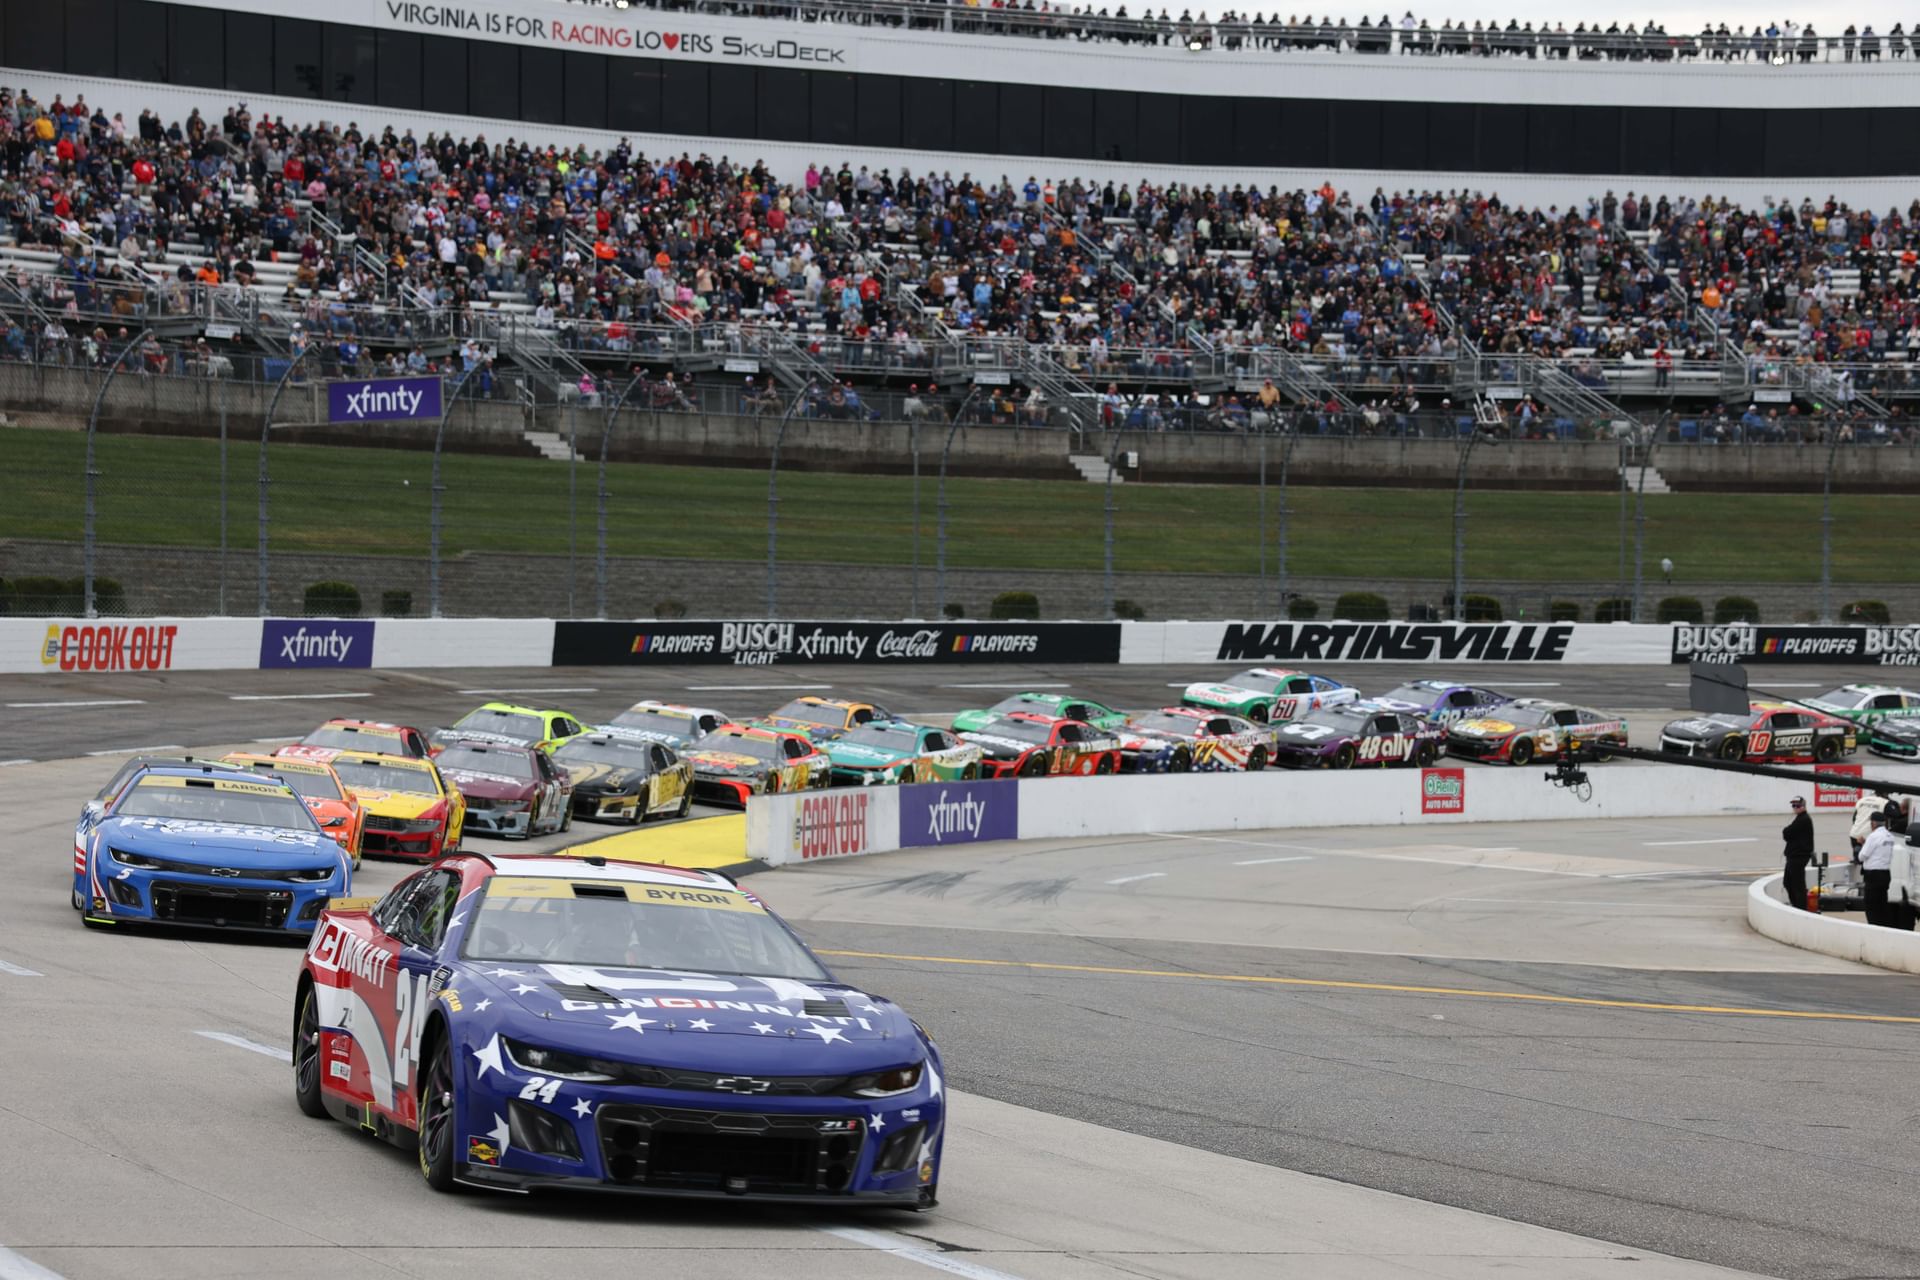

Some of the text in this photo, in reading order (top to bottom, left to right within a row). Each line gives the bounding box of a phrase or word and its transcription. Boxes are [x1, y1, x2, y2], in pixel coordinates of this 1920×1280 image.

[387, 0, 481, 32] VIRGINIA
[486, 12, 501, 34] IS
[505, 15, 547, 39] FOR
[552, 20, 632, 49] RACING
[346, 384, 423, 418] xfinity
[60, 625, 177, 671] COOK OUT
[280, 626, 353, 663] xfinity
[650, 635, 716, 653] PLAYOFFS
[720, 623, 796, 653] BUSCH
[797, 627, 869, 660] xfinity
[970, 635, 1039, 652] PLAYOFFS
[1215, 623, 1576, 661] MARTINSVILLE
[1676, 627, 1758, 655] BUSCH
[1783, 638, 1857, 654] PLAYOFFS
[734, 652, 777, 665] LIGHT
[1271, 698, 1298, 720] 60
[1359, 733, 1415, 762] 48 ally
[1537, 728, 1558, 752] 3
[1746, 731, 1772, 755] 10
[222, 782, 278, 795] LARSON
[928, 789, 985, 841] xfinity
[1425, 799, 1461, 809] AUTO PARTS
[801, 792, 868, 859] COOK OUT
[116, 868, 135, 880] 5
[645, 888, 731, 905] BYRON
[519, 1076, 563, 1104] 24
